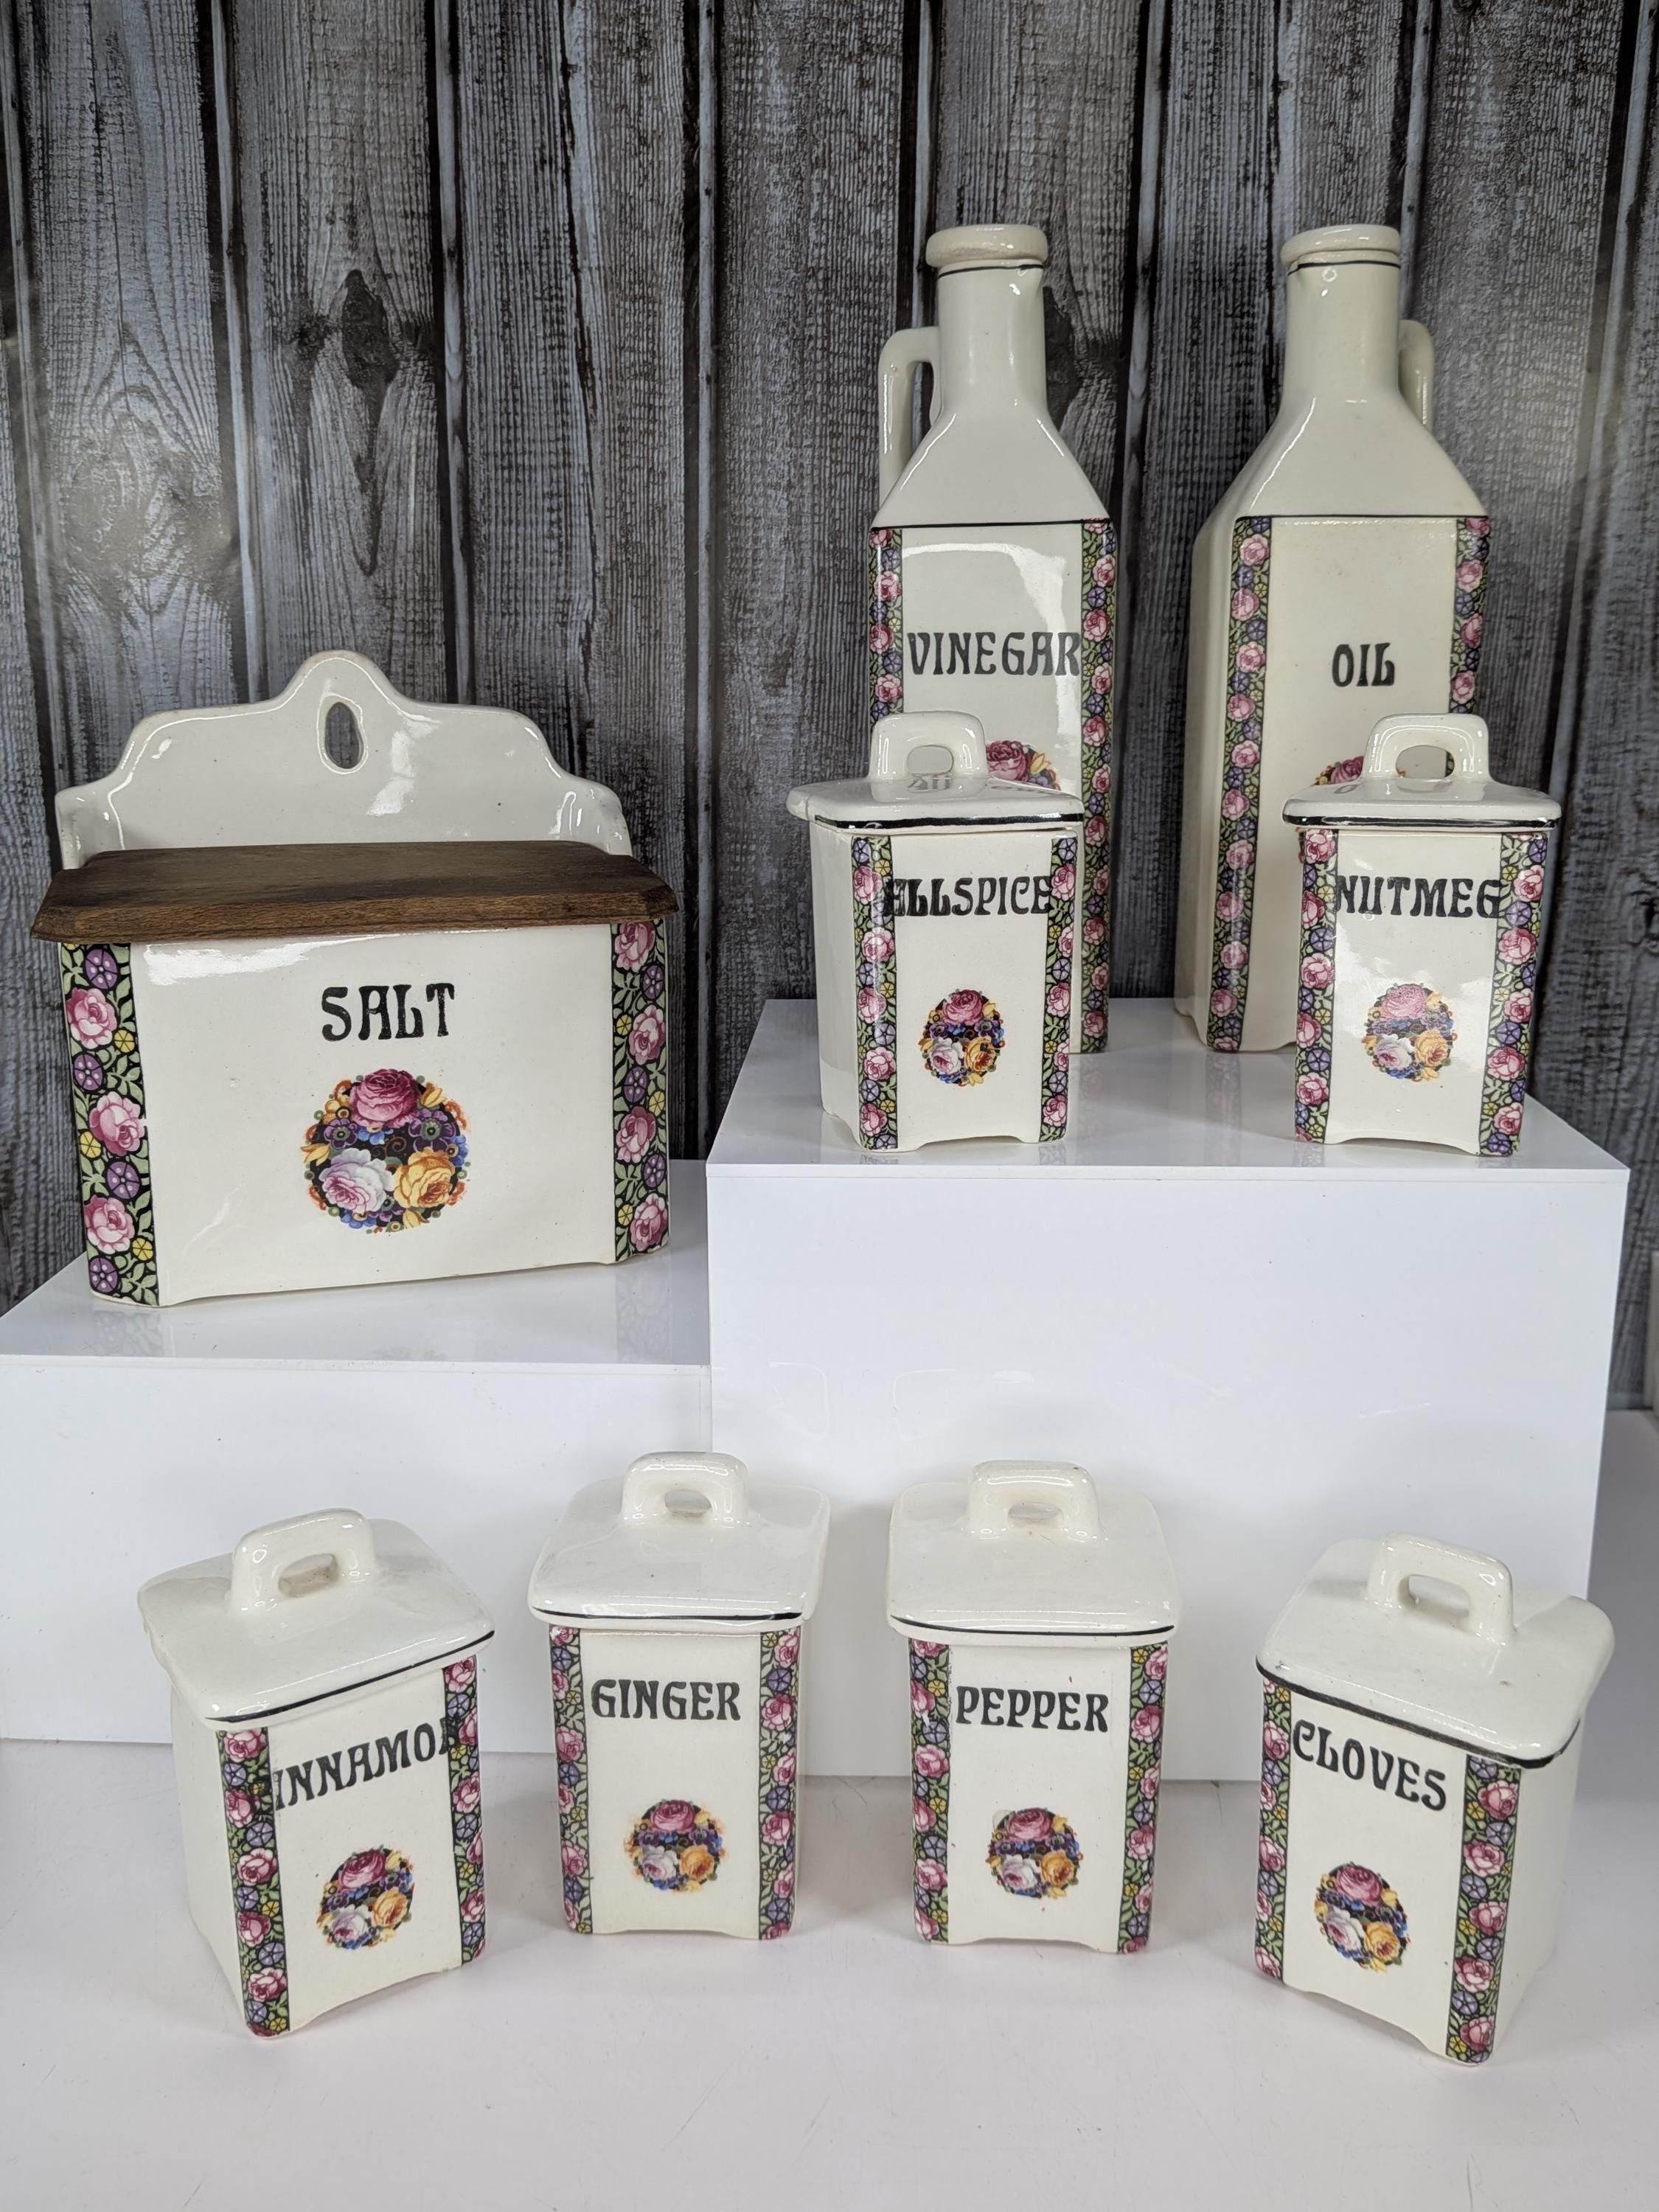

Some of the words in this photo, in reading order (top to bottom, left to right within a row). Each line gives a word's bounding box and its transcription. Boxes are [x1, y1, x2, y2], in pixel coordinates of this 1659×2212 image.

[907, 631, 1082, 677] VINEGAR
[1332, 642, 1395, 687] OIL
[1336, 874, 1500, 919] NUTMEG
[321, 983, 455, 1042] SALT
[591, 1678, 741, 1721] GINGER
[956, 1686, 1109, 1733] PEPPER
[1293, 1719, 1447, 1811] CLOVES
